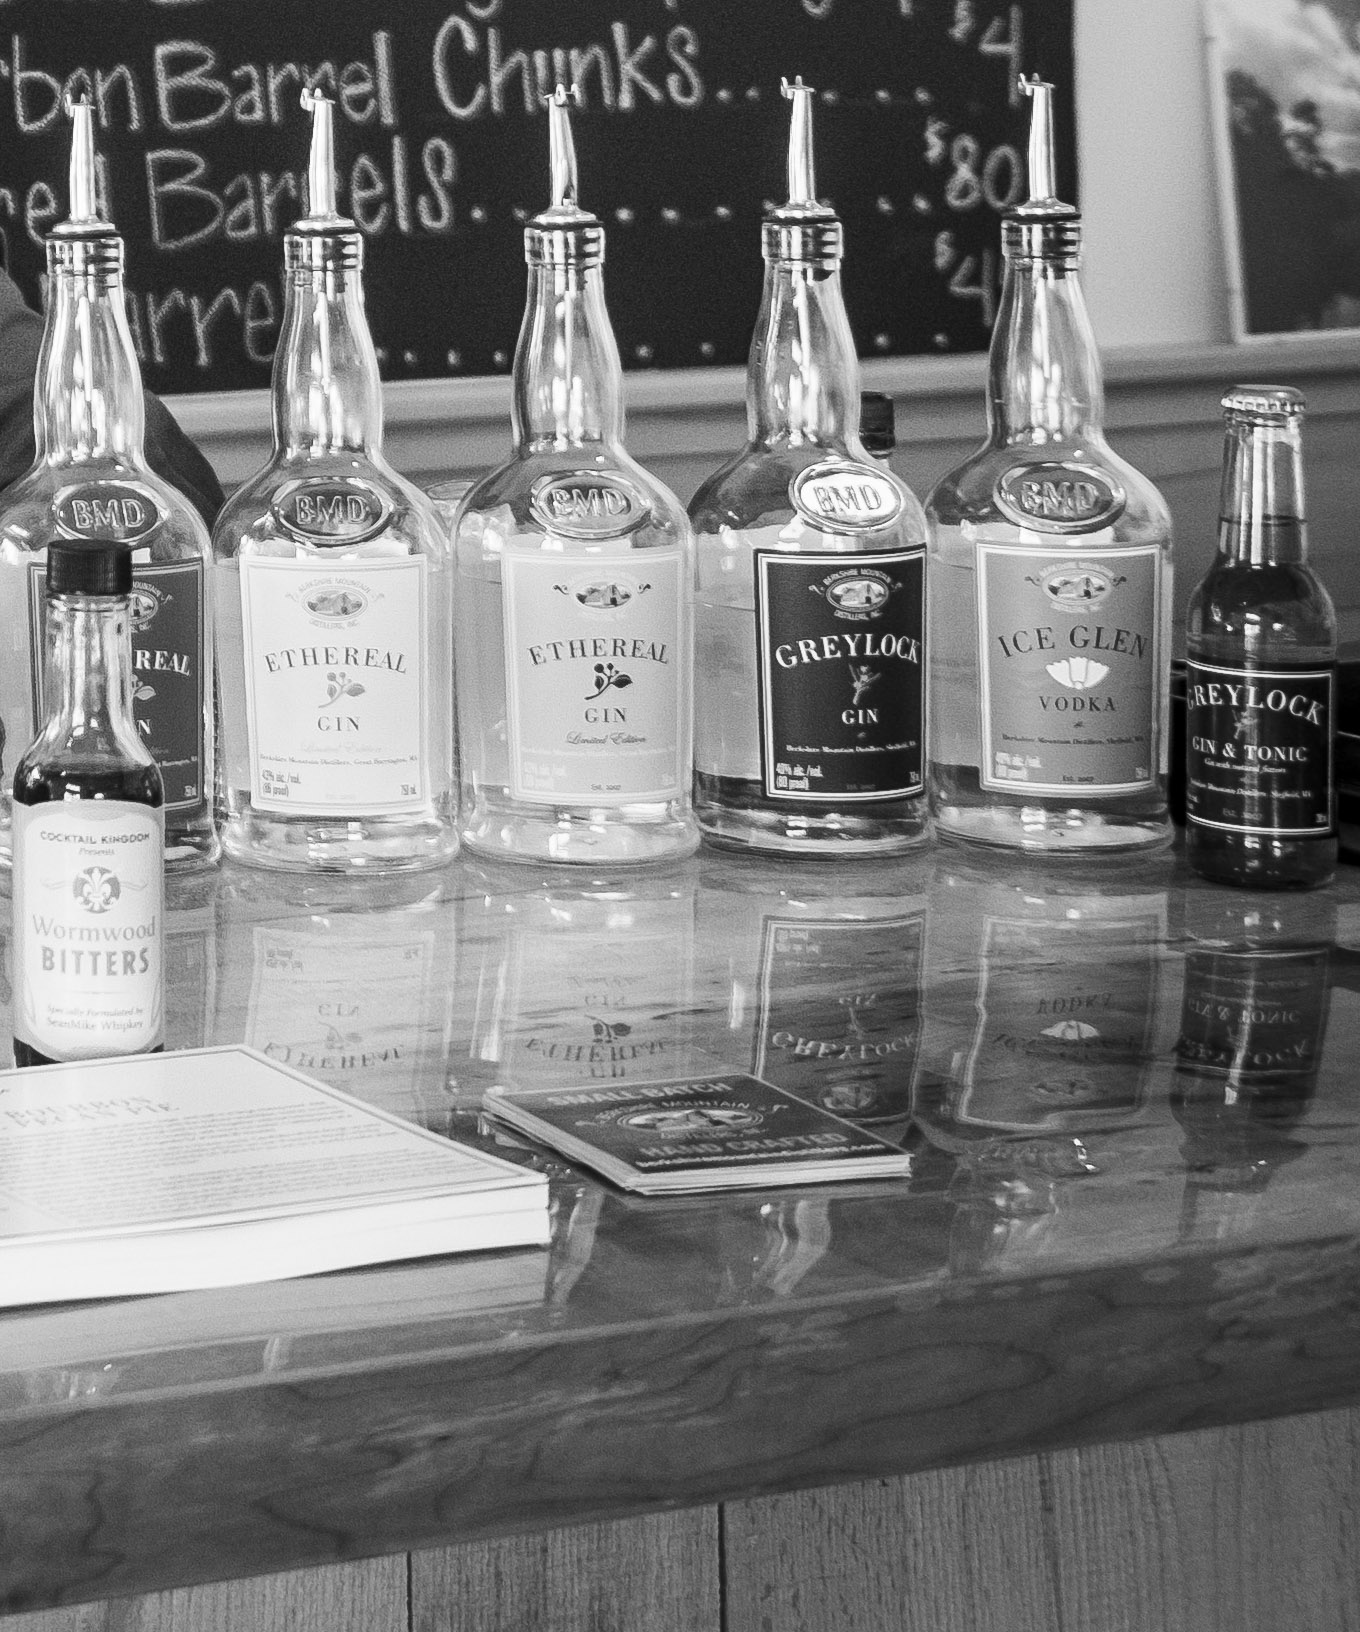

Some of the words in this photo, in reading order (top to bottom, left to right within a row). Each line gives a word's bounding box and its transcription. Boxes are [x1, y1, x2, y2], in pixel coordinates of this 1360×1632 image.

[153, 30, 395, 131] Barrel
[71, 498, 146, 530] BMD
[295, 495, 369, 525] BMD
[814, 485, 882, 515] BMD
[527, 637, 669, 666] ETHEREAL
[775, 633, 921, 668] GREYLOCK
[998, 627, 1056, 658] ICE
[1069, 625, 1148, 659] GLEN
[134, 649, 191, 677] REAL
[264, 645, 407, 674] ETHEREAL
[584, 707, 628, 723] GIN
[842, 709, 879, 725] GIN
[1039, 696, 1117, 712] VODKA
[317, 716, 361, 732] GIN
[1192, 736, 1217, 755] GIN
[1222, 743, 1236, 758] &
[1244, 745, 1308, 762] TONIC
[40, 831, 97, 845] COCKTAIL
[101, 832, 150, 845] KINGDOM
[32, 913, 157, 943] Wormwood
[41, 945, 149, 977] BITTERS
[547, 1088, 638, 1108] SMALL
[641, 1080, 734, 1099] BATCH
[640, 1141, 724, 1157] HAND
[725, 1132, 848, 1151] CRAFTED
